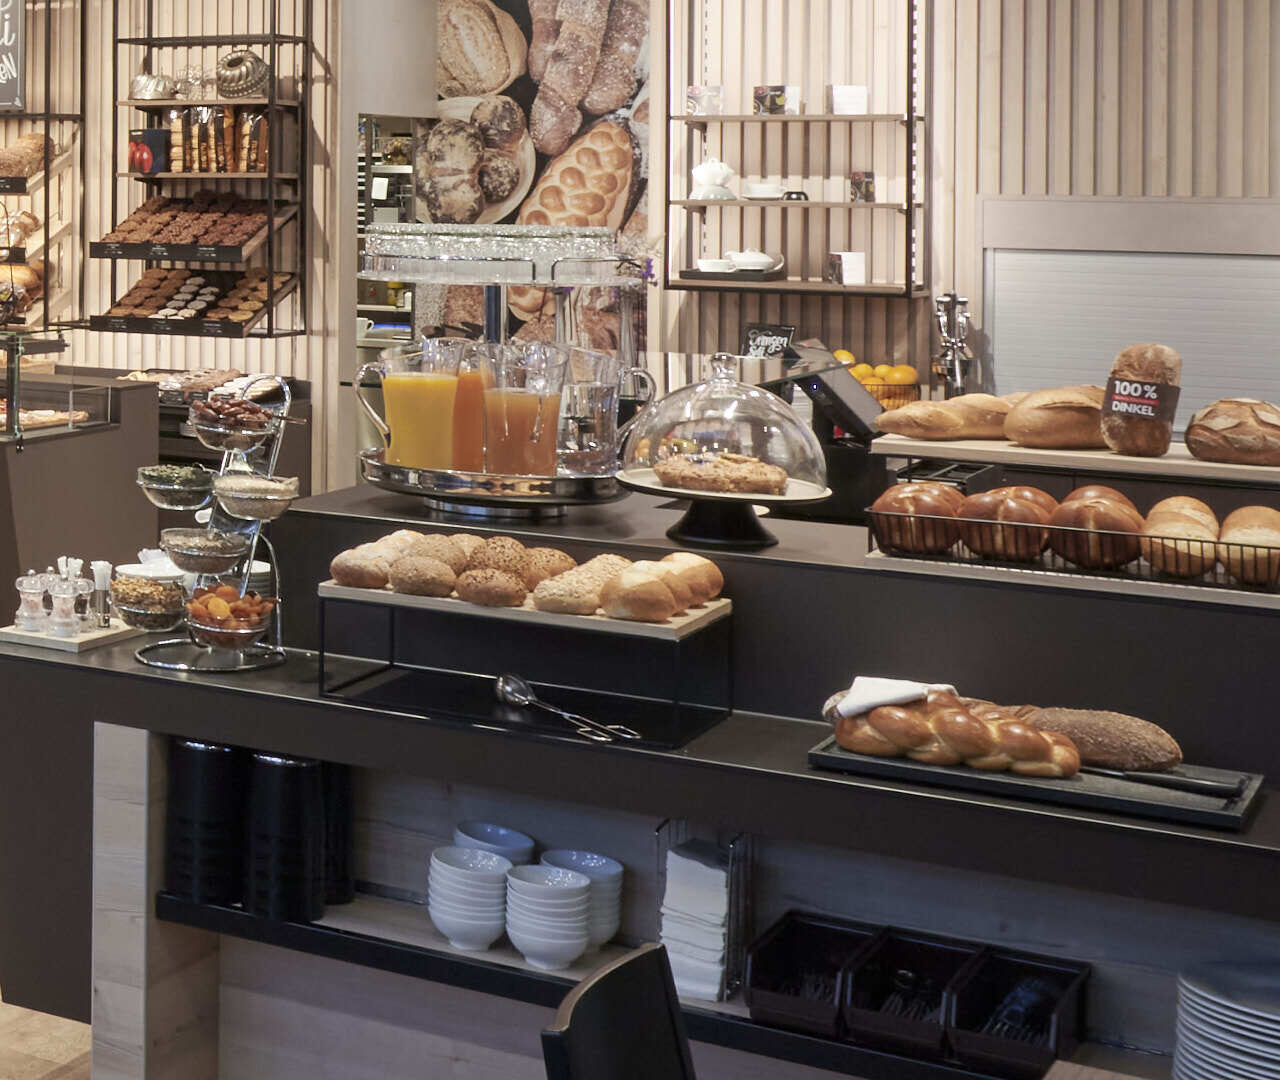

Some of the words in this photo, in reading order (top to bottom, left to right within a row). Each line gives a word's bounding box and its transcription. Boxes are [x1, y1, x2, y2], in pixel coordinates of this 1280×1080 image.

[1114, 380, 1142, 397] 100
[1143, 384, 1158, 399] %
[1111, 401, 1156, 416] DINKEL
